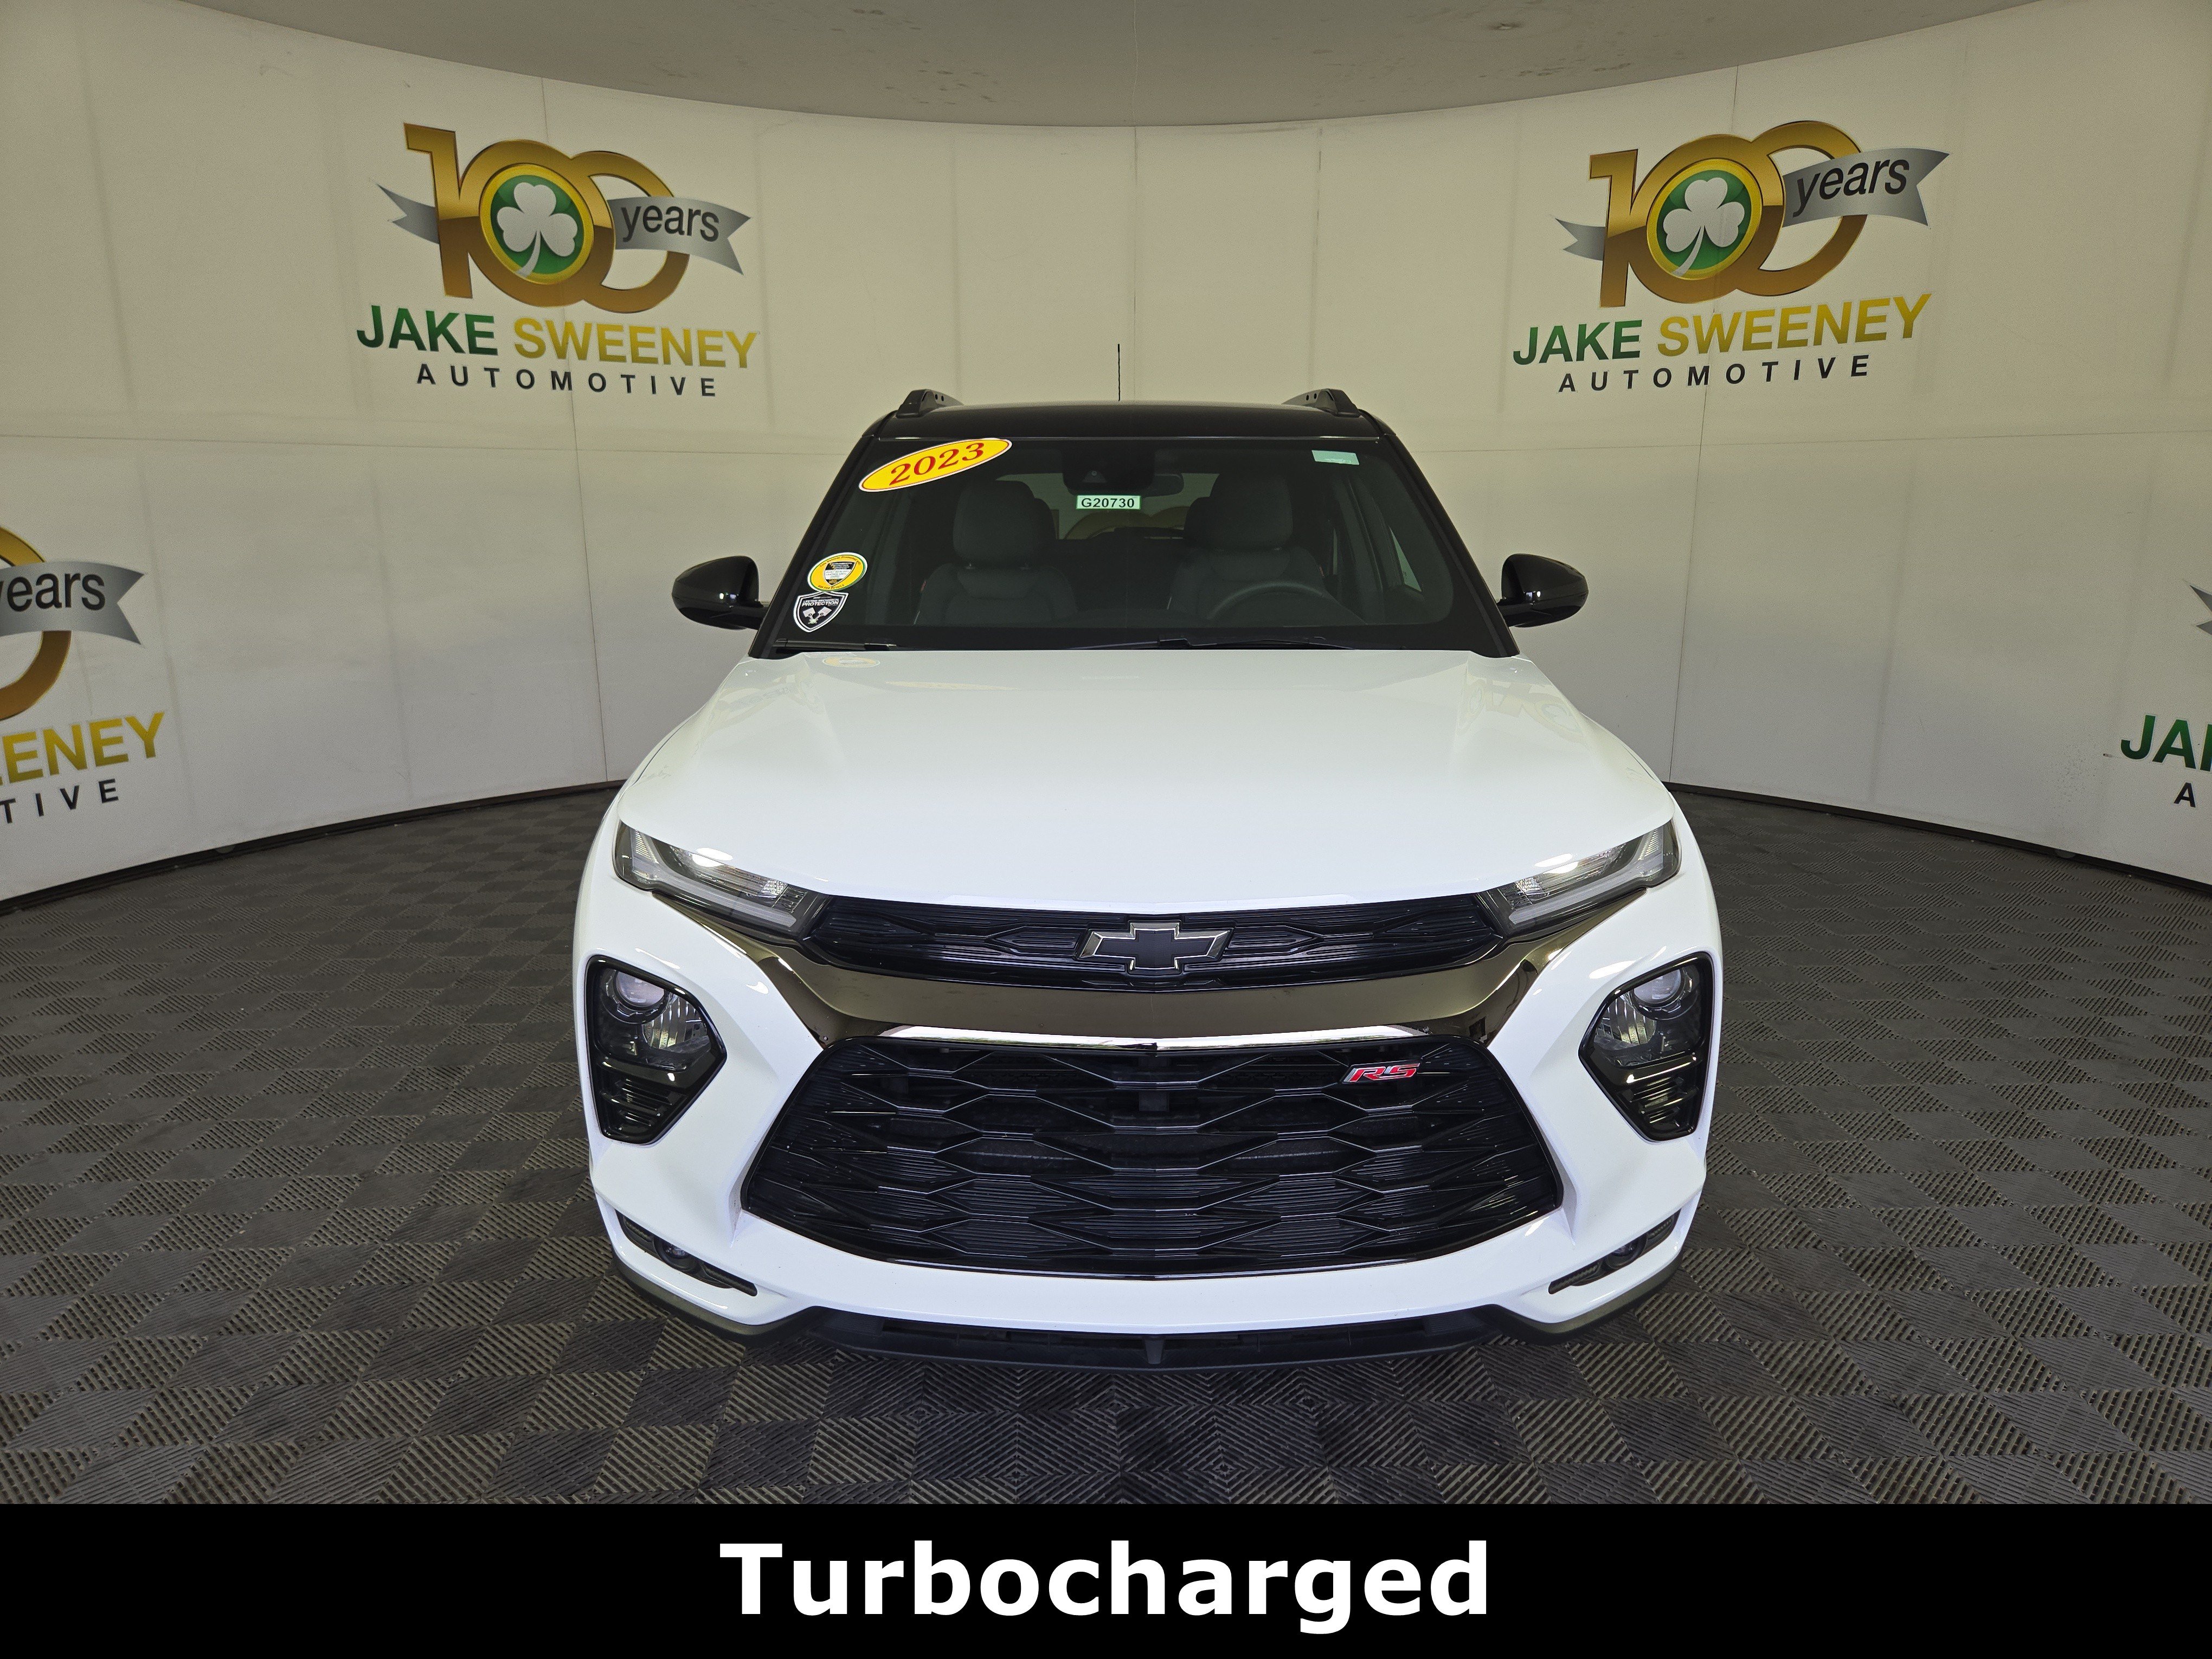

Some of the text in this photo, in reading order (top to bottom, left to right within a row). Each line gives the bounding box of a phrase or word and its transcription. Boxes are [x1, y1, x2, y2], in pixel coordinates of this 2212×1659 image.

[1793, 159, 1910, 216] years
[621, 204, 720, 242] years
[356, 305, 758, 369] JAKE SWEENEY
[1513, 293, 1932, 365] JAKE SWEENEY
[416, 363, 717, 397] AUTOMOTIVE
[1558, 354, 1869, 394] AUTOMOTIVE
[889, 442, 985, 486] 2023
[1081, 498, 1135, 507] G20730
[0, 573, 106, 612] ears
[2120, 715, 2212, 772] JA
[1343, 1063, 1420, 1082] RS
